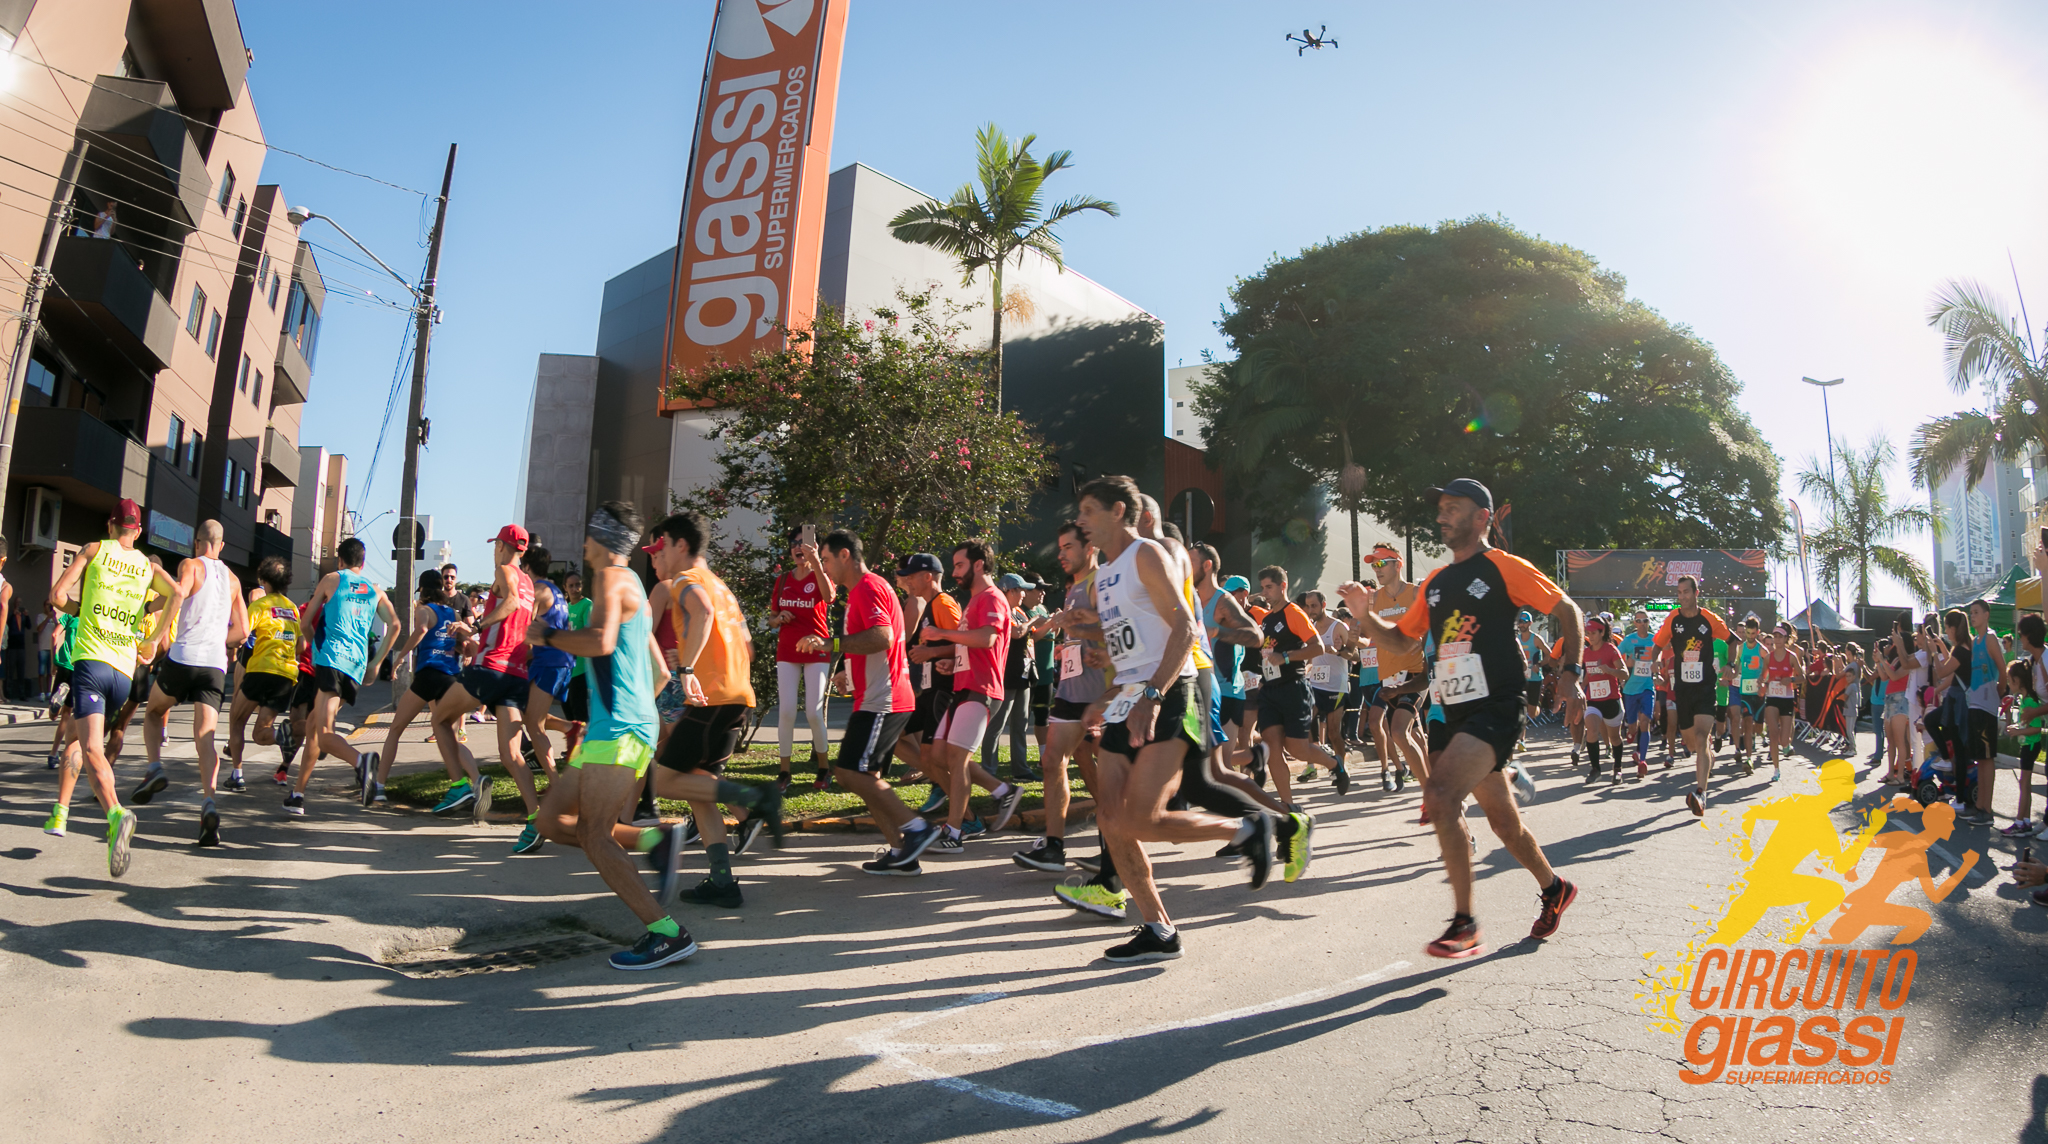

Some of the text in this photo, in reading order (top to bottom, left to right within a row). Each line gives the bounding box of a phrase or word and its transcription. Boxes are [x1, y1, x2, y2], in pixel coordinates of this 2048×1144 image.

[764, 65, 807, 270] SUPERMERCADOS
[684, 69, 781, 347] giassi
[102, 552, 147, 578] Impact
[1667, 561, 1701, 573] CIRCUITO
[93, 603, 137, 627] eudajo
[1362, 656, 1377, 667] 509
[1313, 672, 1326, 681] 153
[1637, 667, 1650, 675] 203
[1684, 670, 1701, 679] 188
[1441, 674, 1476, 698] 222
[1592, 688, 1607, 697] 739
[653, 942, 670, 955] FILA
